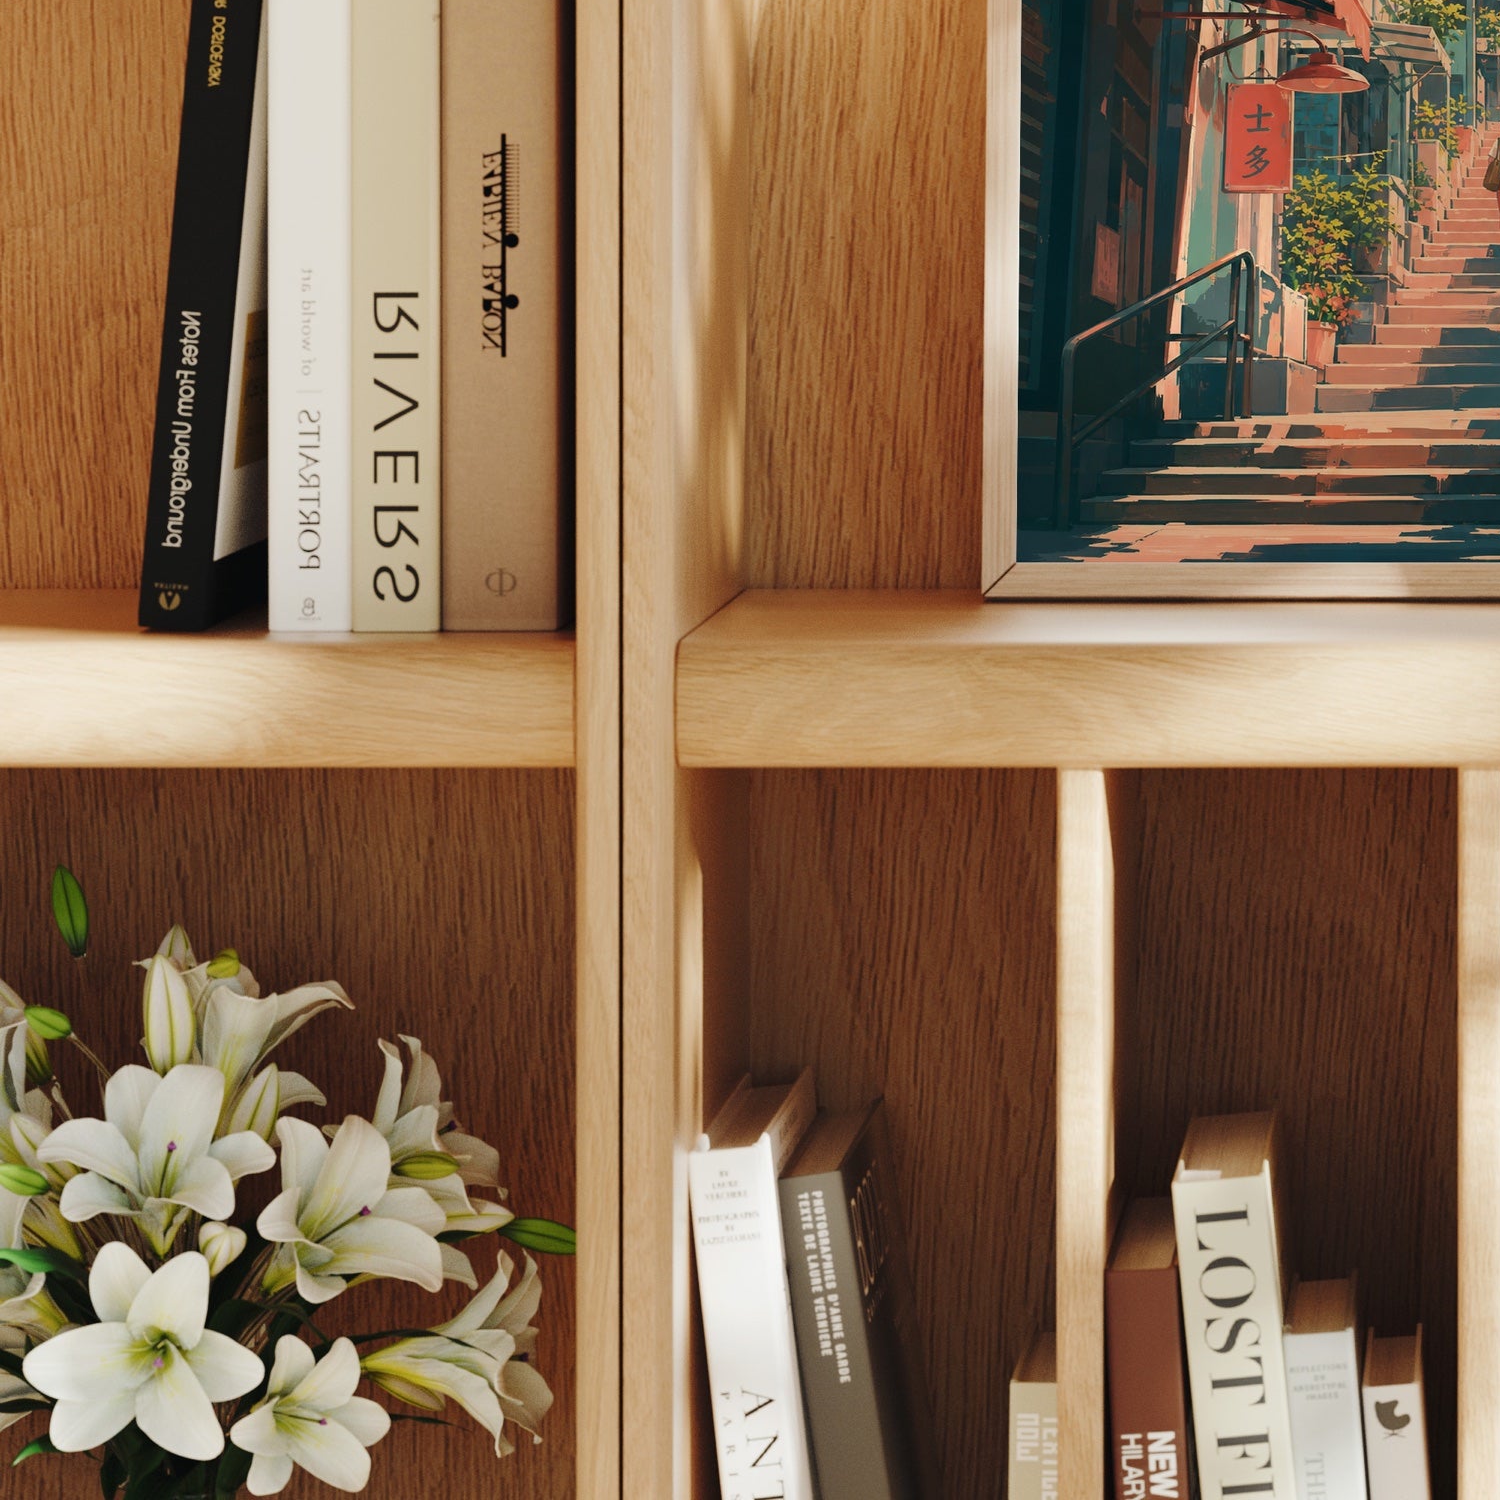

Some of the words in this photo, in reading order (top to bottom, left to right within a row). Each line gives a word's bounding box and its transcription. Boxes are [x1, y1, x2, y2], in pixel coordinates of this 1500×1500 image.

[1241, 103, 1274, 179] 士多
[797, 1192, 814, 1231] TEXTE
[804, 1233, 817, 1250] DE
[811, 1190, 837, 1290] PHOTOGRAPHIES
[806, 1254, 823, 1293] LAURE
[827, 1293, 845, 1339] D'ANNE
[1194, 1204, 1267, 1406] LOST
[834, 1343, 852, 1384] GARDE
[1016, 1412, 1040, 1462] NOW
[1147, 1431, 1179, 1499] NEW
